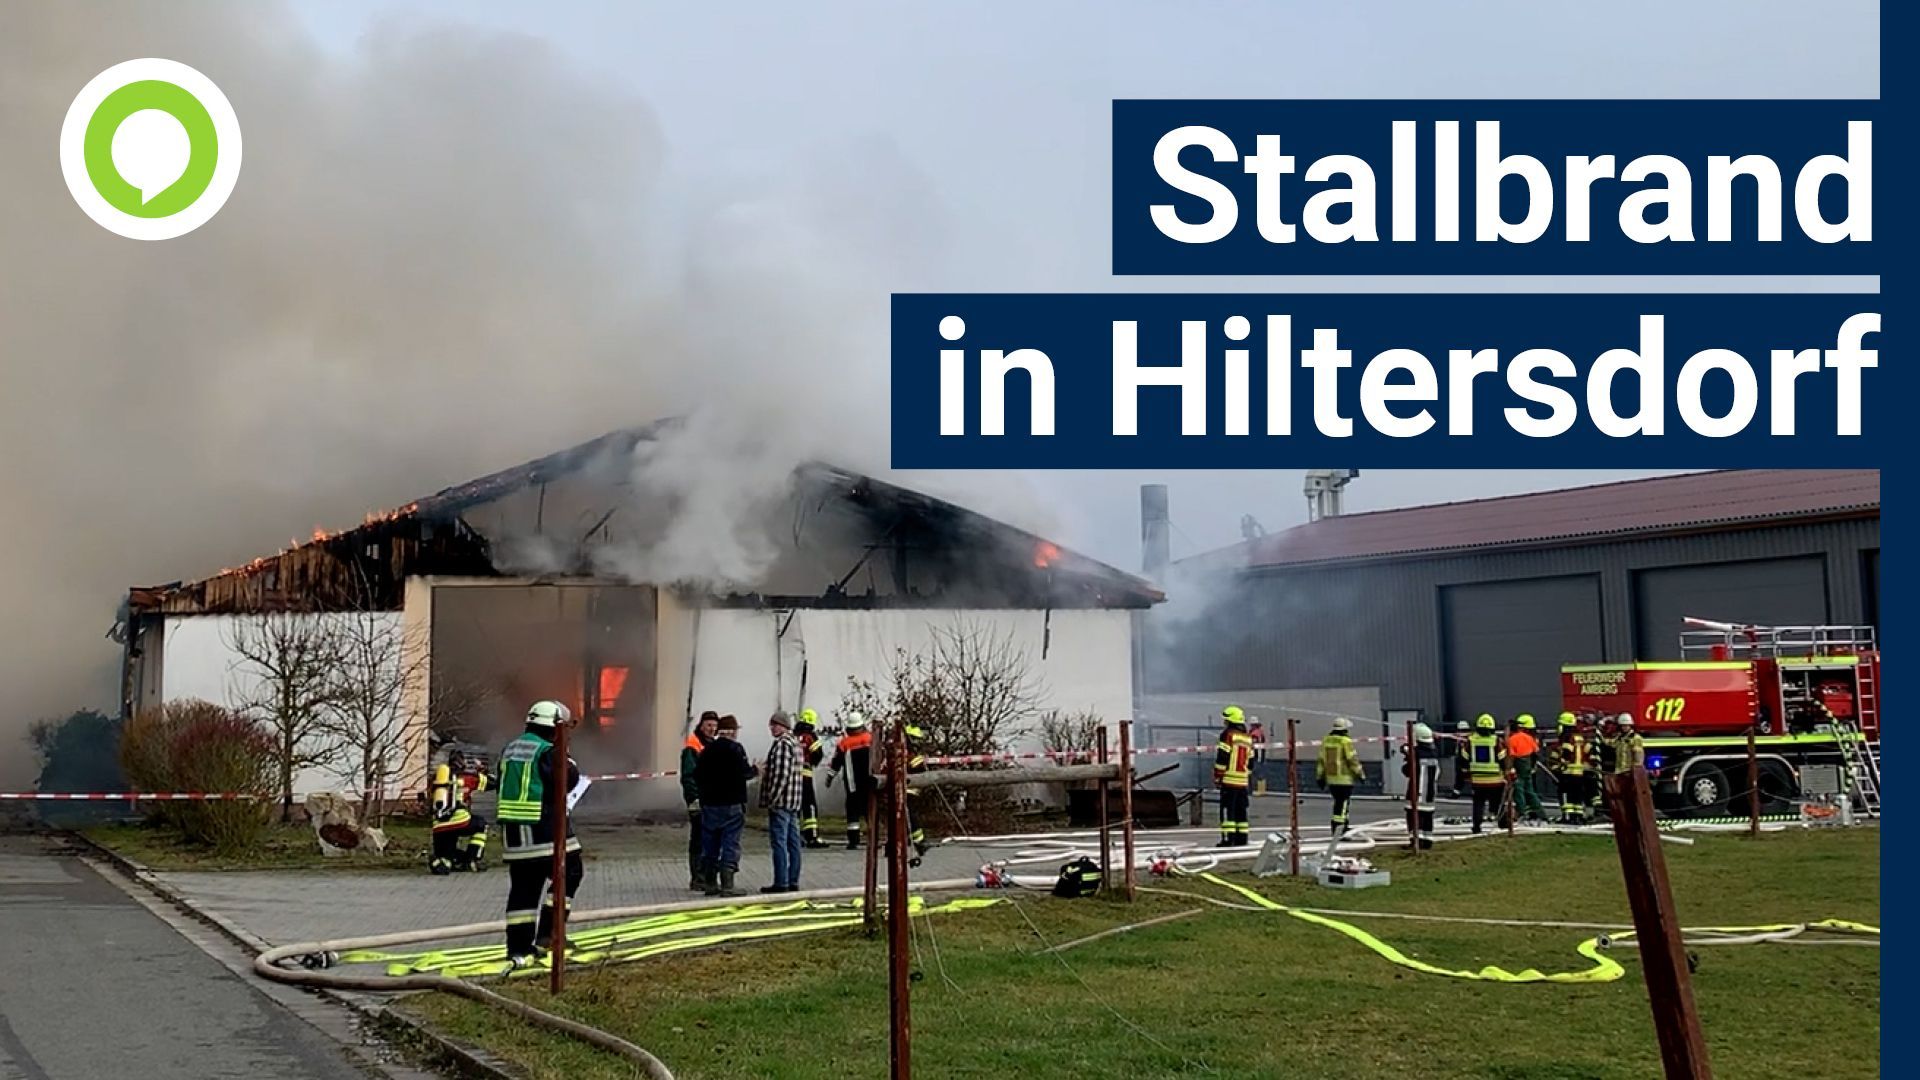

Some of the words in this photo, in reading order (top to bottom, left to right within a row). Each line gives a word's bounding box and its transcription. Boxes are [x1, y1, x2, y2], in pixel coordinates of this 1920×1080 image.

[1572, 671, 1626, 684] FEUERWEHR
[1580, 683, 1618, 695] AMBERG
[1655, 697, 1685, 721] 112
